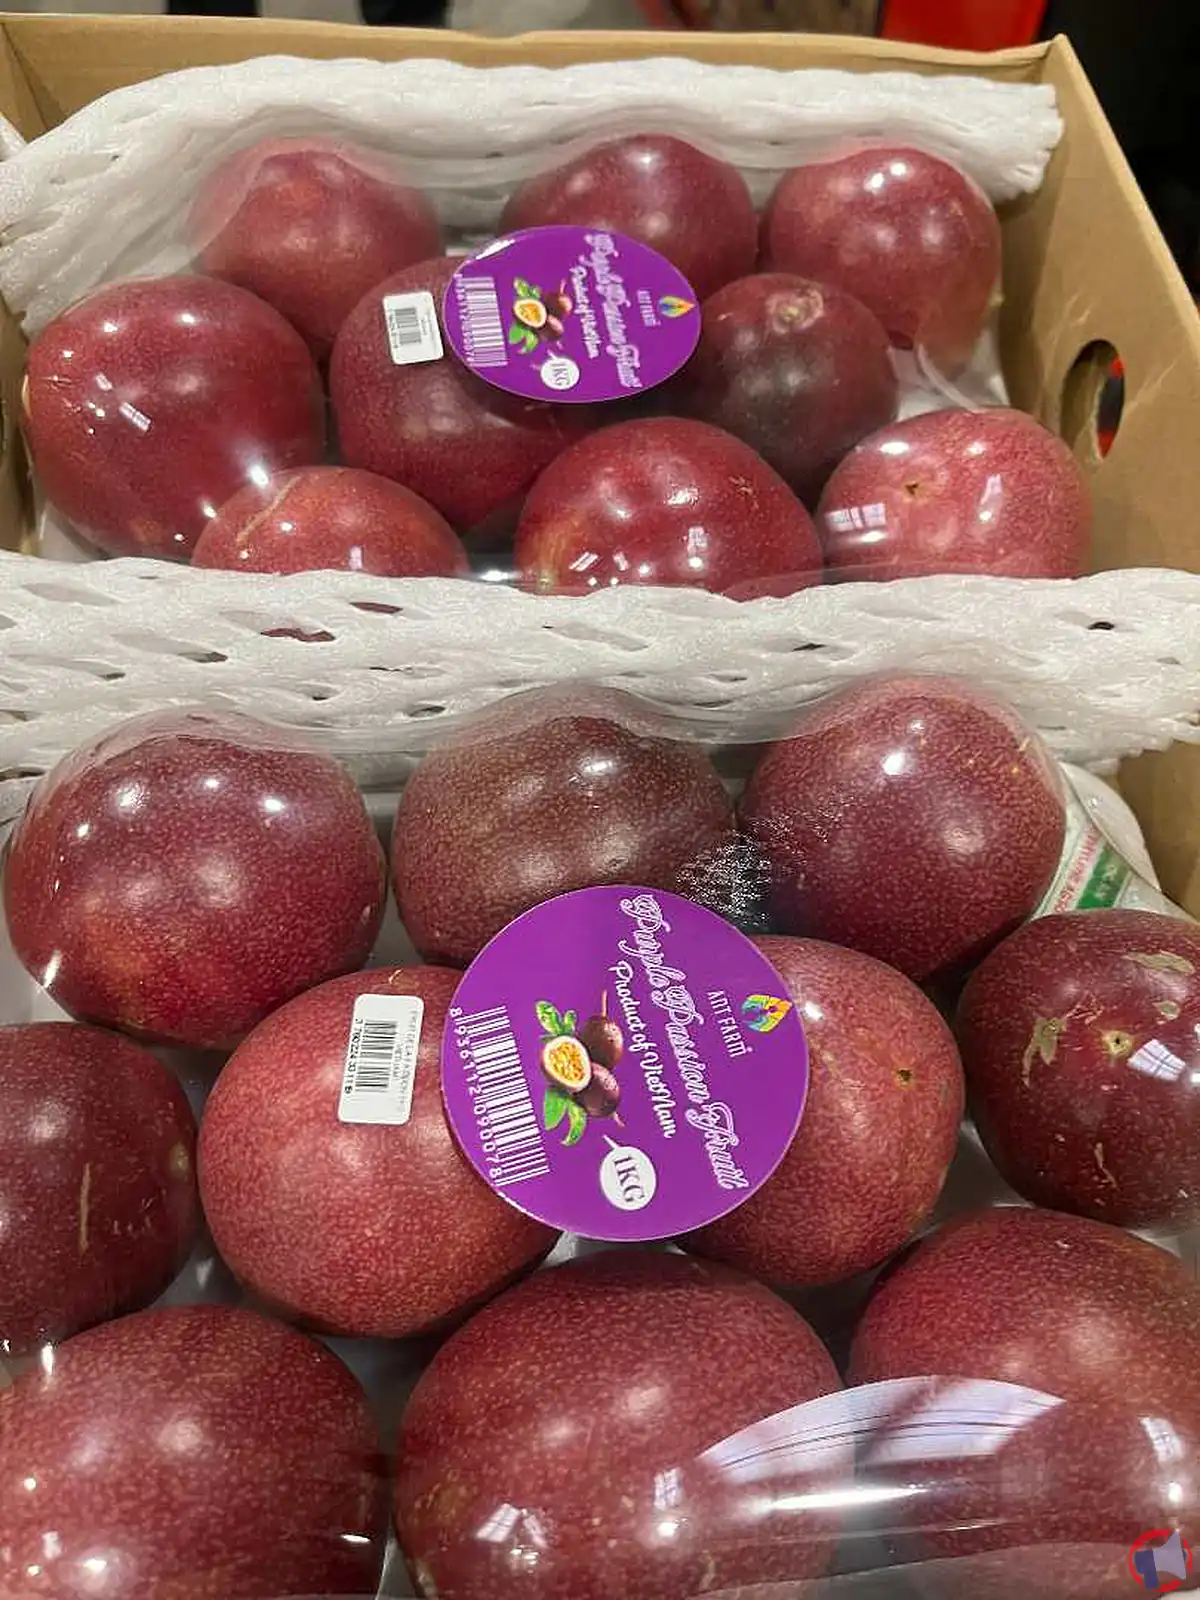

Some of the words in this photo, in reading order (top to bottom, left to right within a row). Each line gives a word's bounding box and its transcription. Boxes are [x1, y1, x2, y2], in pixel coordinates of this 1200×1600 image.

[552, 362, 571, 386] 1KG
[618, 894, 688, 988] Purple
[608, 960, 647, 1033] Product
[707, 990, 732, 1015] ART
[628, 1033, 657, 1053] of
[651, 985, 711, 1103] Passion
[717, 1017, 746, 1057] FARM
[640, 1053, 677, 1139] VietNam
[685, 1102, 749, 1189] Fruit
[614, 1156, 646, 1202] 1KG
